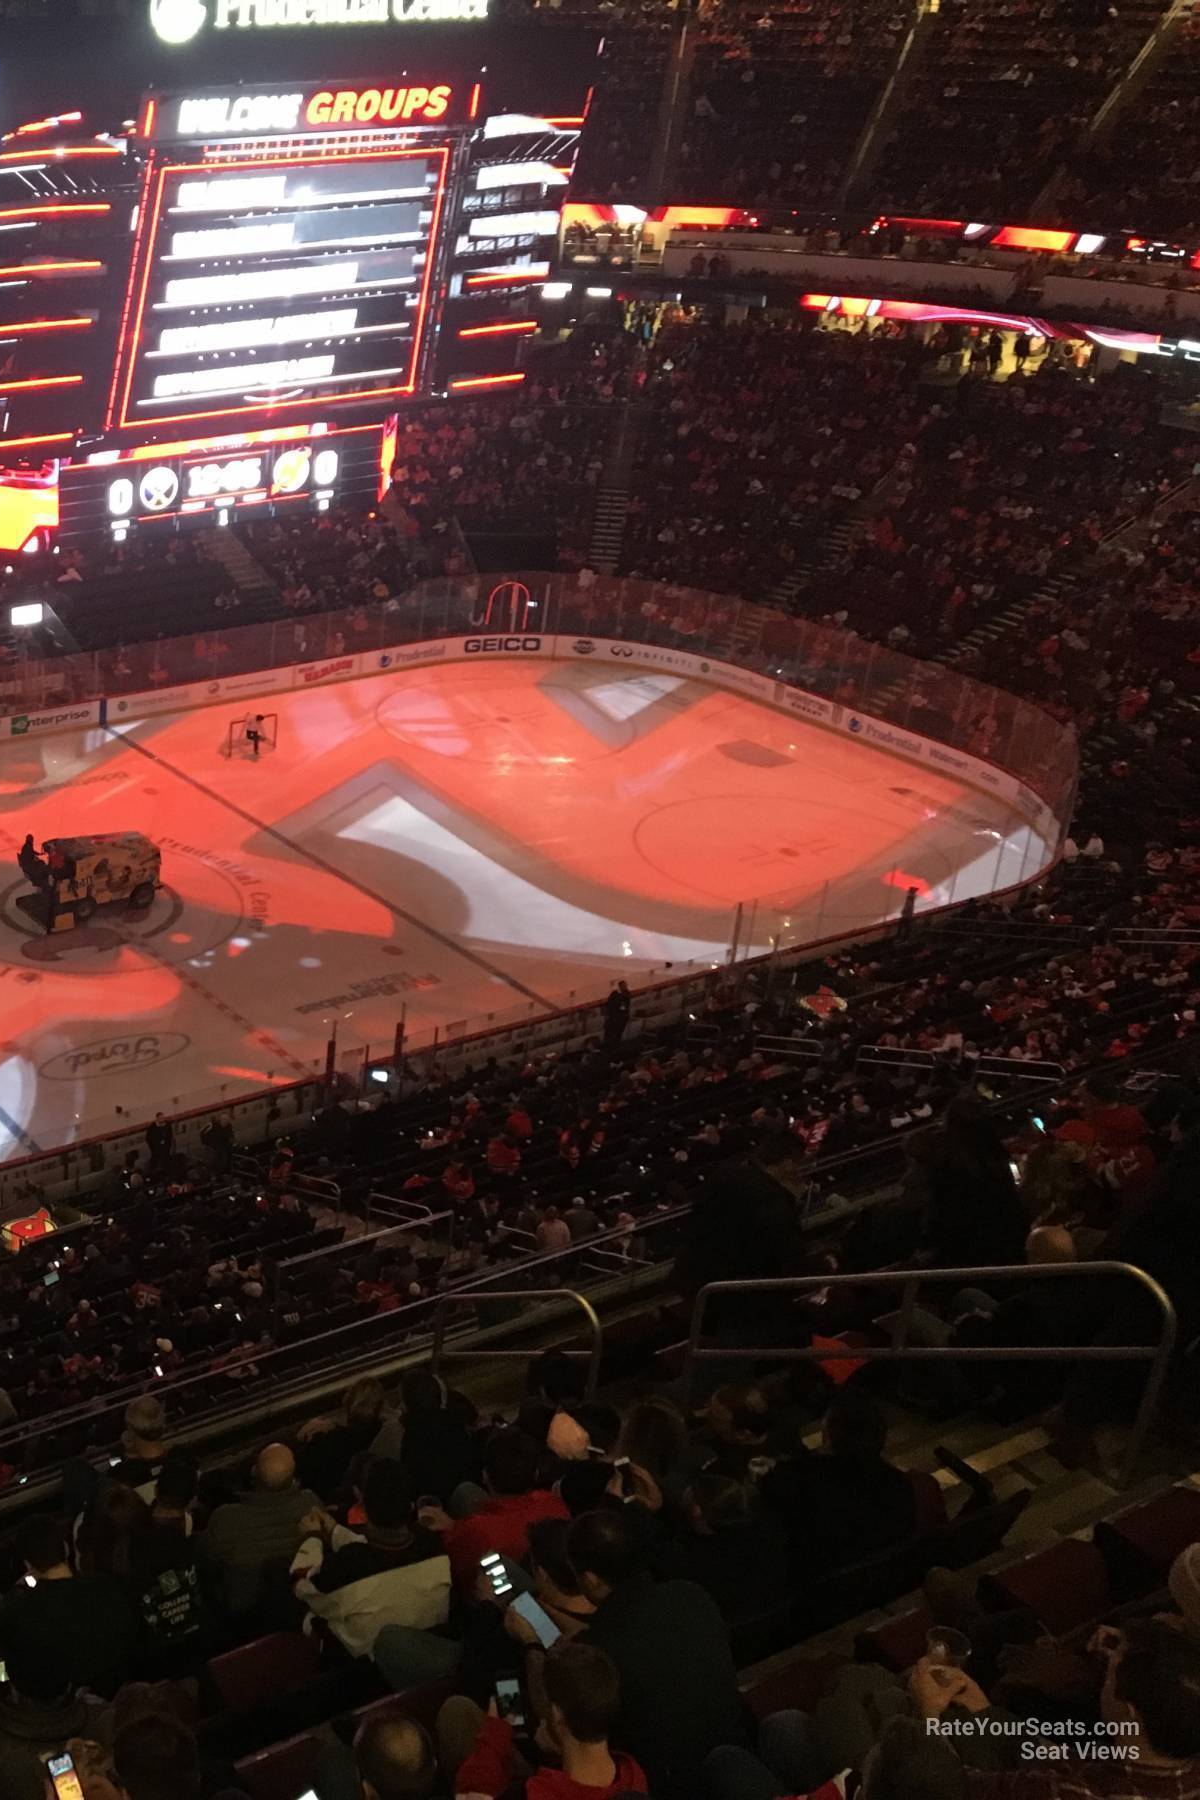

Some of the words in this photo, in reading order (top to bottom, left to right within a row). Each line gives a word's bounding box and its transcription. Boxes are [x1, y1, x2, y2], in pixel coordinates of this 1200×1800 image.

[305, 86, 452, 126] GROUPS
[395, 645, 447, 664] Prudential
[464, 637, 541, 653] GEICO
[157, 837, 263, 886] Prudential
[64, 1036, 161, 1073] Ford
